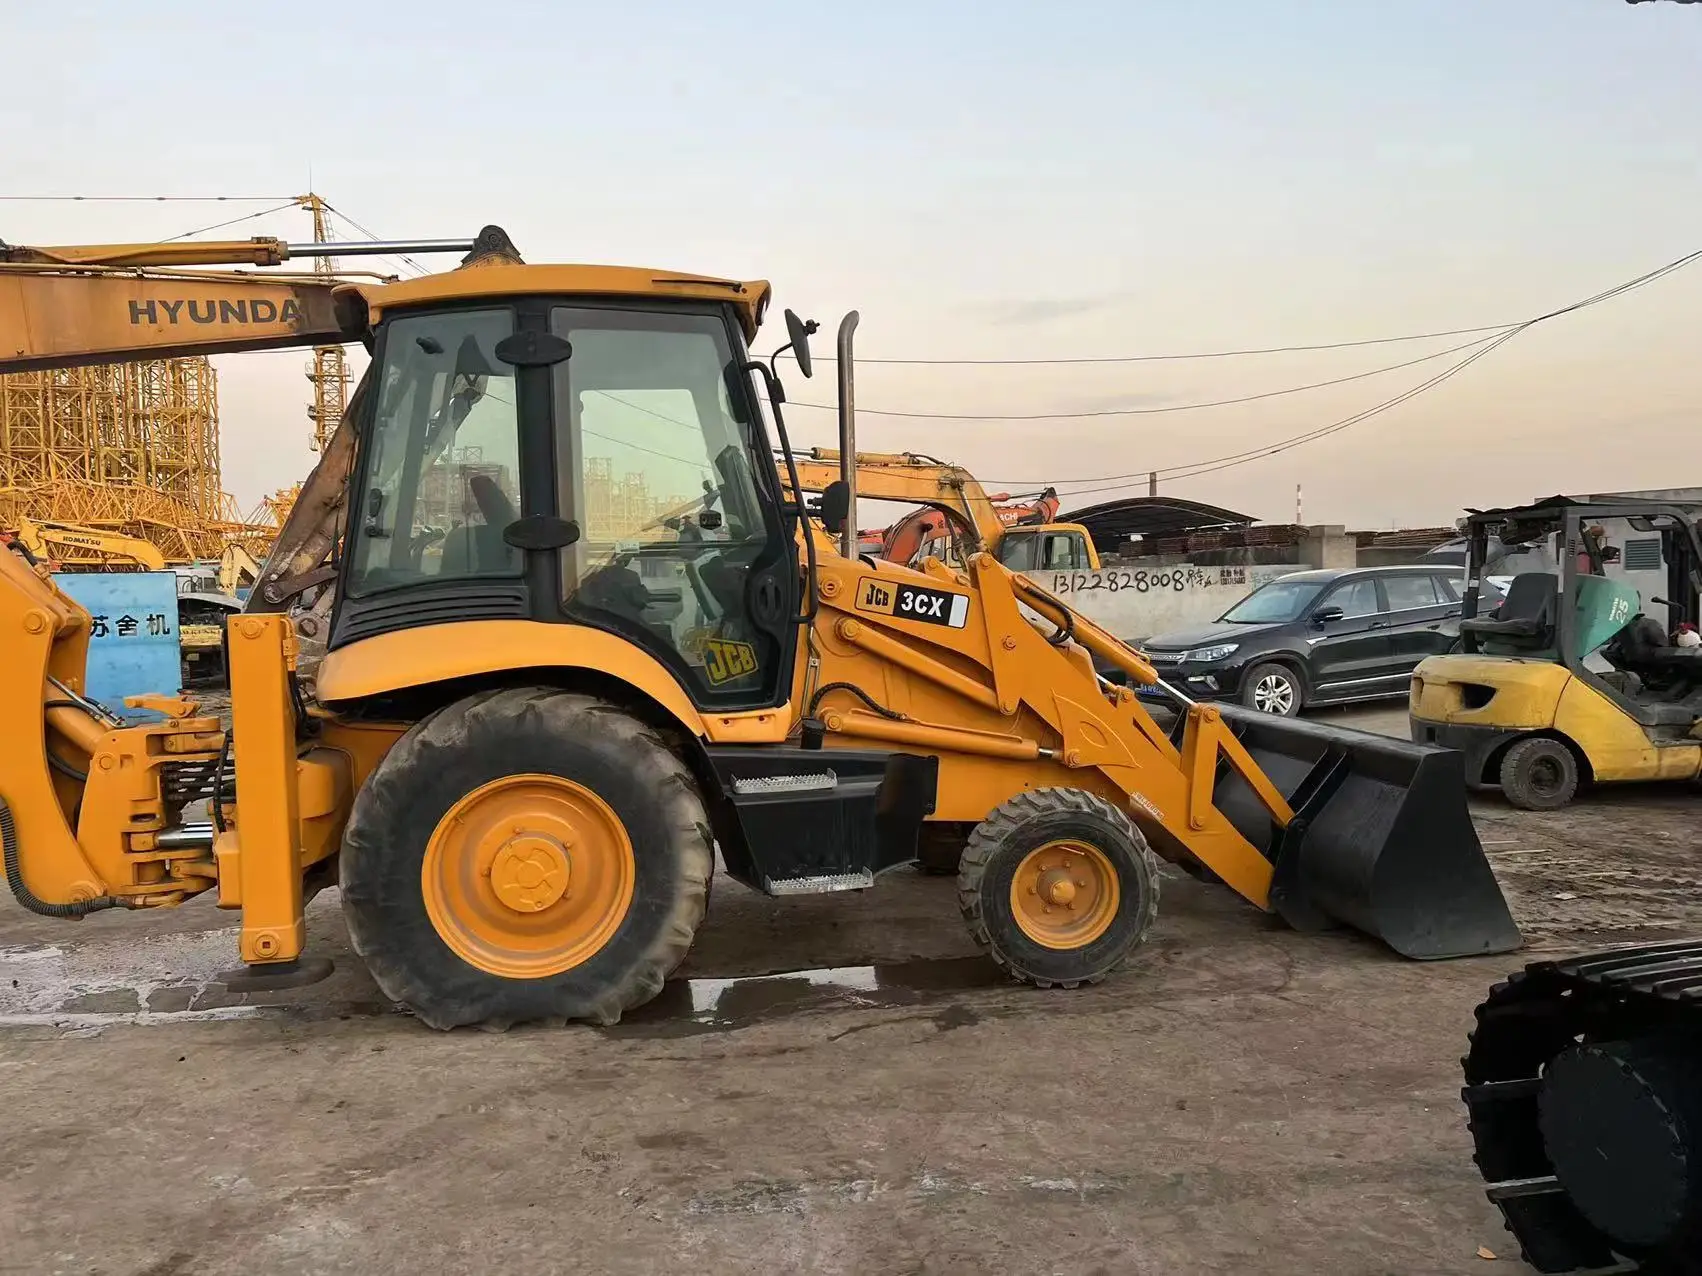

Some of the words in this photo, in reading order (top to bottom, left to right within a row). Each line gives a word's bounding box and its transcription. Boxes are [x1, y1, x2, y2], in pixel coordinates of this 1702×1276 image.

[63, 535, 101, 546] KOMATSU
[1053, 570, 1184, 594] 13122828008
[865, 583, 889, 607] JCB
[901, 591, 945, 617] 3CX
[1616, 599, 1629, 624] 25
[707, 640, 755, 681] JCB
